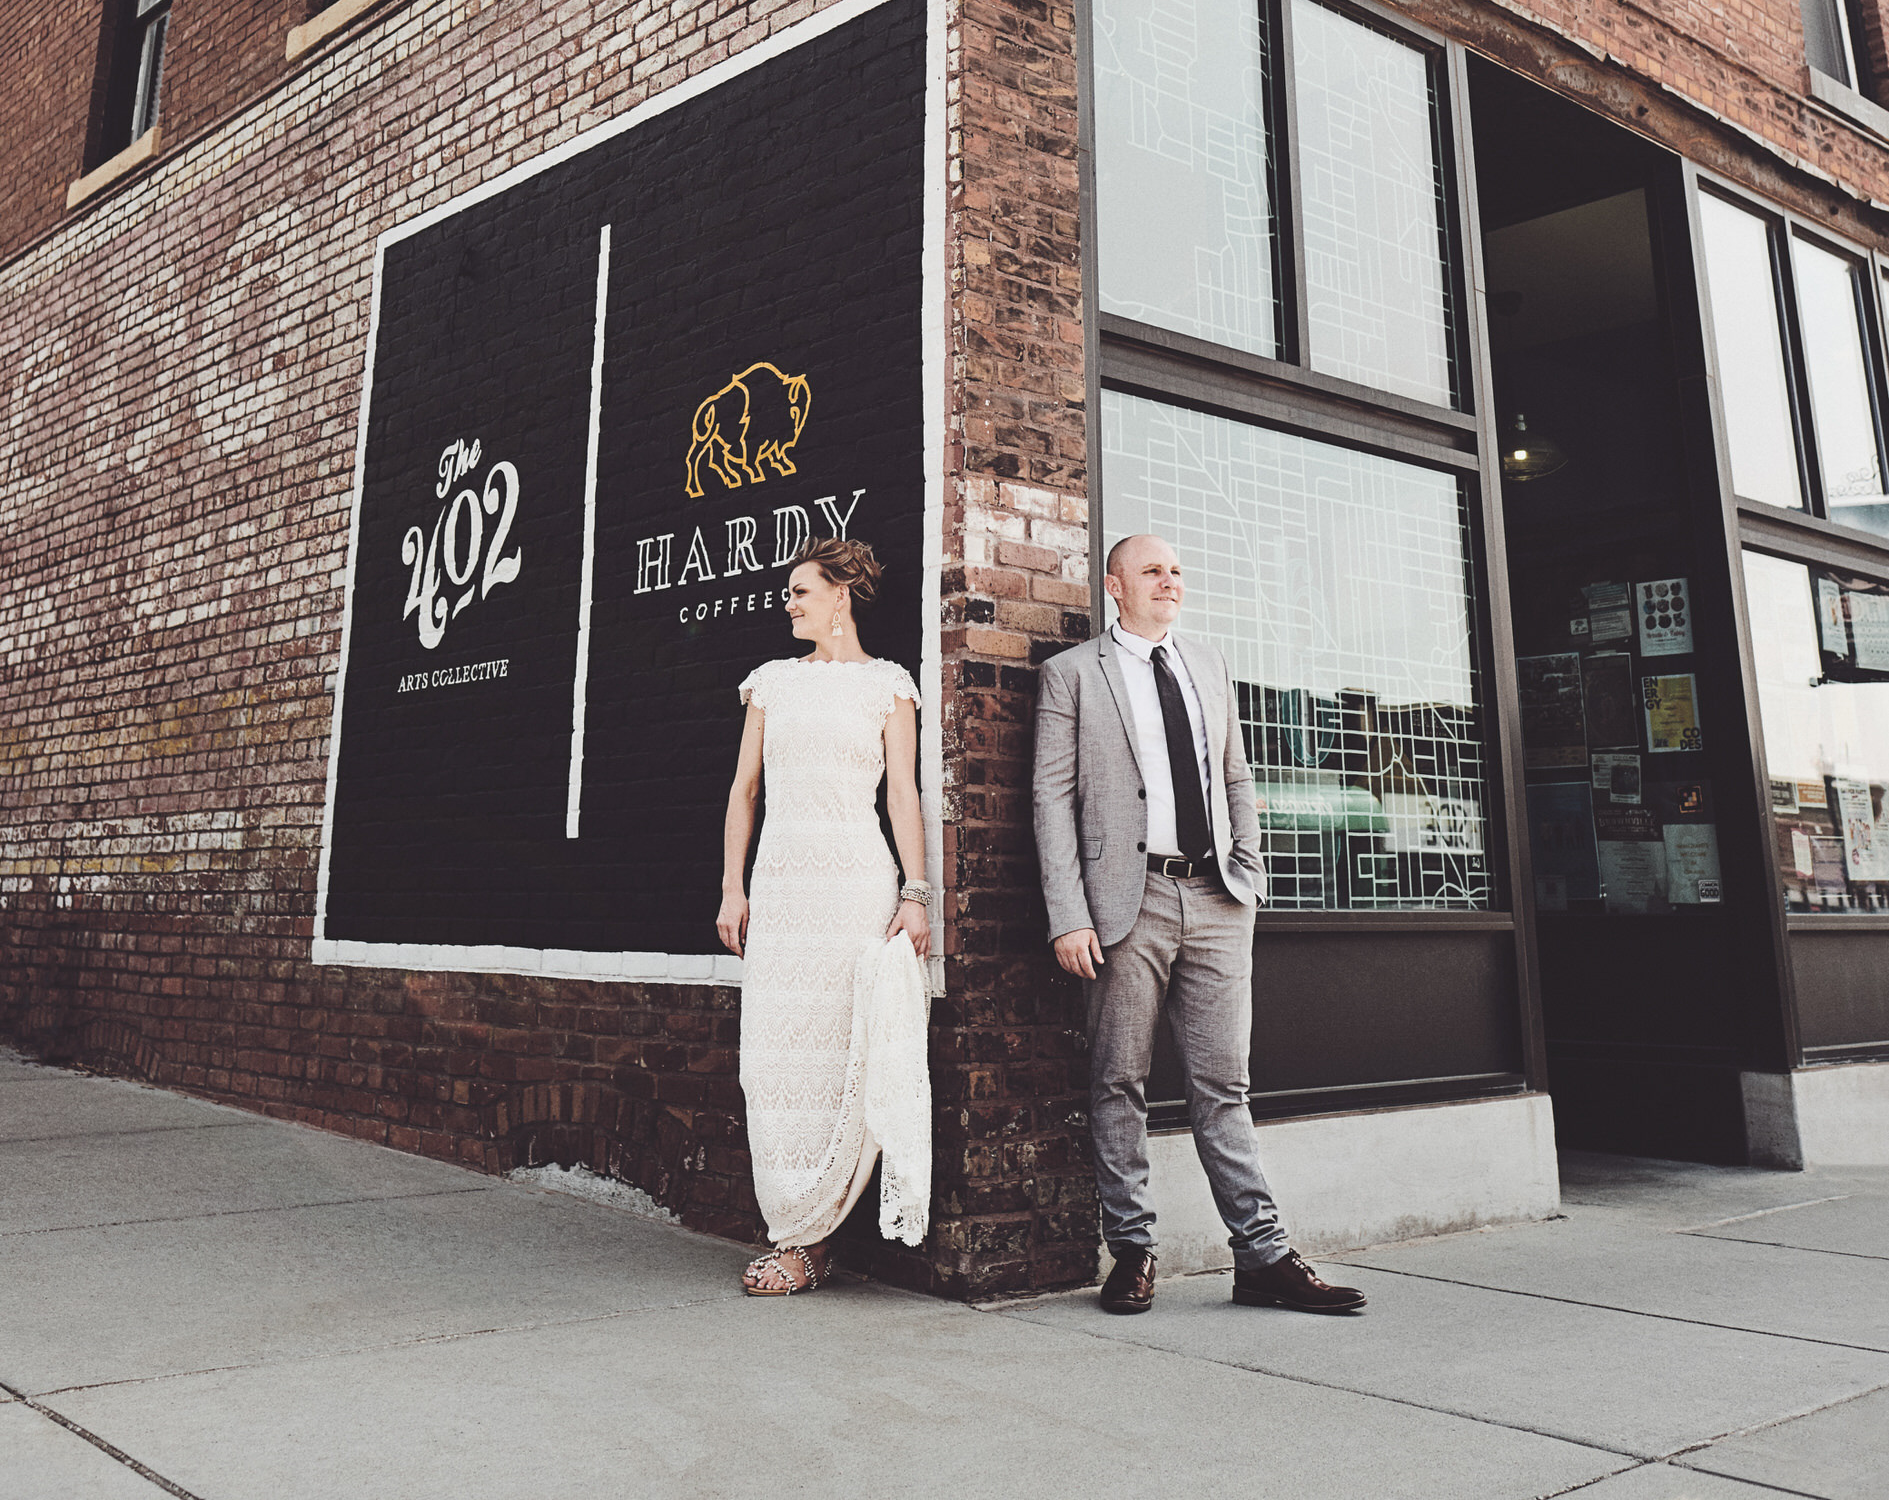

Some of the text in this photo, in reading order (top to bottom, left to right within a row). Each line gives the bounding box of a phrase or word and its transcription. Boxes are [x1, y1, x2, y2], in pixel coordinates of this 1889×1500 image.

[436, 437, 482, 499] The
[633, 488, 866, 595] HARDY
[401, 460, 522, 650] 402
[397, 658, 510, 693] ARTS COLLECTIVE
[1643, 677, 1658, 688] EN
[1644, 688, 1658, 699] ER
[1645, 698, 1662, 710] GY
[1683, 727, 1700, 739] CO
[1679, 738, 1702, 750] DES
